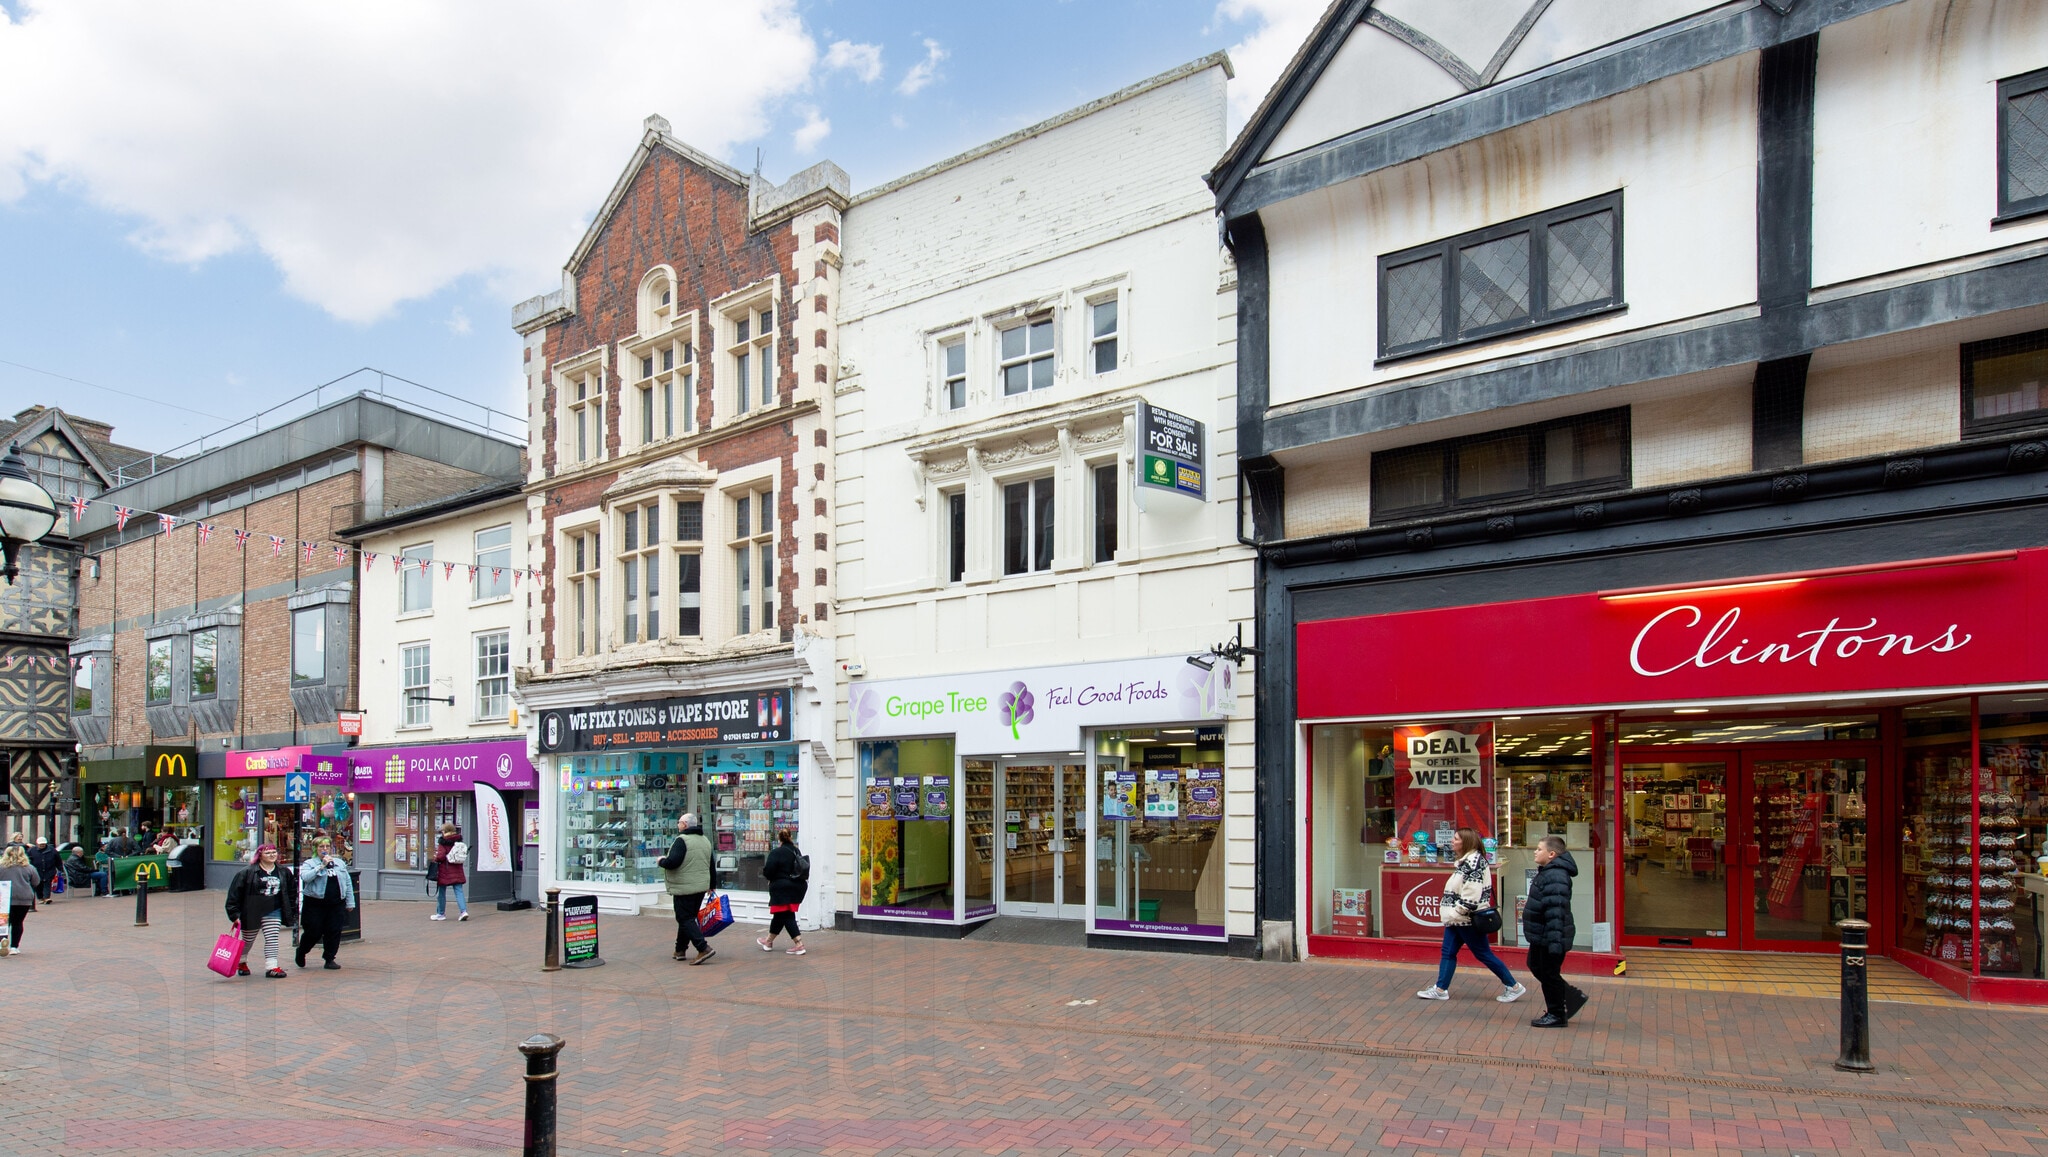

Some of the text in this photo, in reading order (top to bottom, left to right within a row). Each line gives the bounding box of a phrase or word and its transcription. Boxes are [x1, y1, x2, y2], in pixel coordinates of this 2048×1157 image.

[1152, 407, 1195, 427] RETAIL INVESTMENT
[1154, 416, 1194, 434] WITH RESIDENTIAL
[1163, 426, 1187, 439] CONSENT
[1150, 430, 1198, 456] FOR SALE
[1630, 604, 1971, 677] Clintons
[1045, 680, 1168, 709] Feel Good Foods
[886, 691, 988, 720] Grape Tree
[569, 699, 749, 731] WE FIXX FONES & VAPE STORE
[593, 734, 607, 745] BUY
[612, 733, 629, 744] SELL
[635, 731, 661, 743] REPAIR
[667, 727, 718, 742] ACCESSORIES
[1200, 733, 1217, 742] NUT
[1413, 736, 1471, 755] DEAL
[410, 756, 478, 772] POLKA DOT
[1426, 757, 1459, 766] OF THE
[427, 774, 462, 782] TRAVEL
[1415, 768, 1478, 786] WEEK
[1129, 923, 1189, 932] www.grapetree.co.uk
